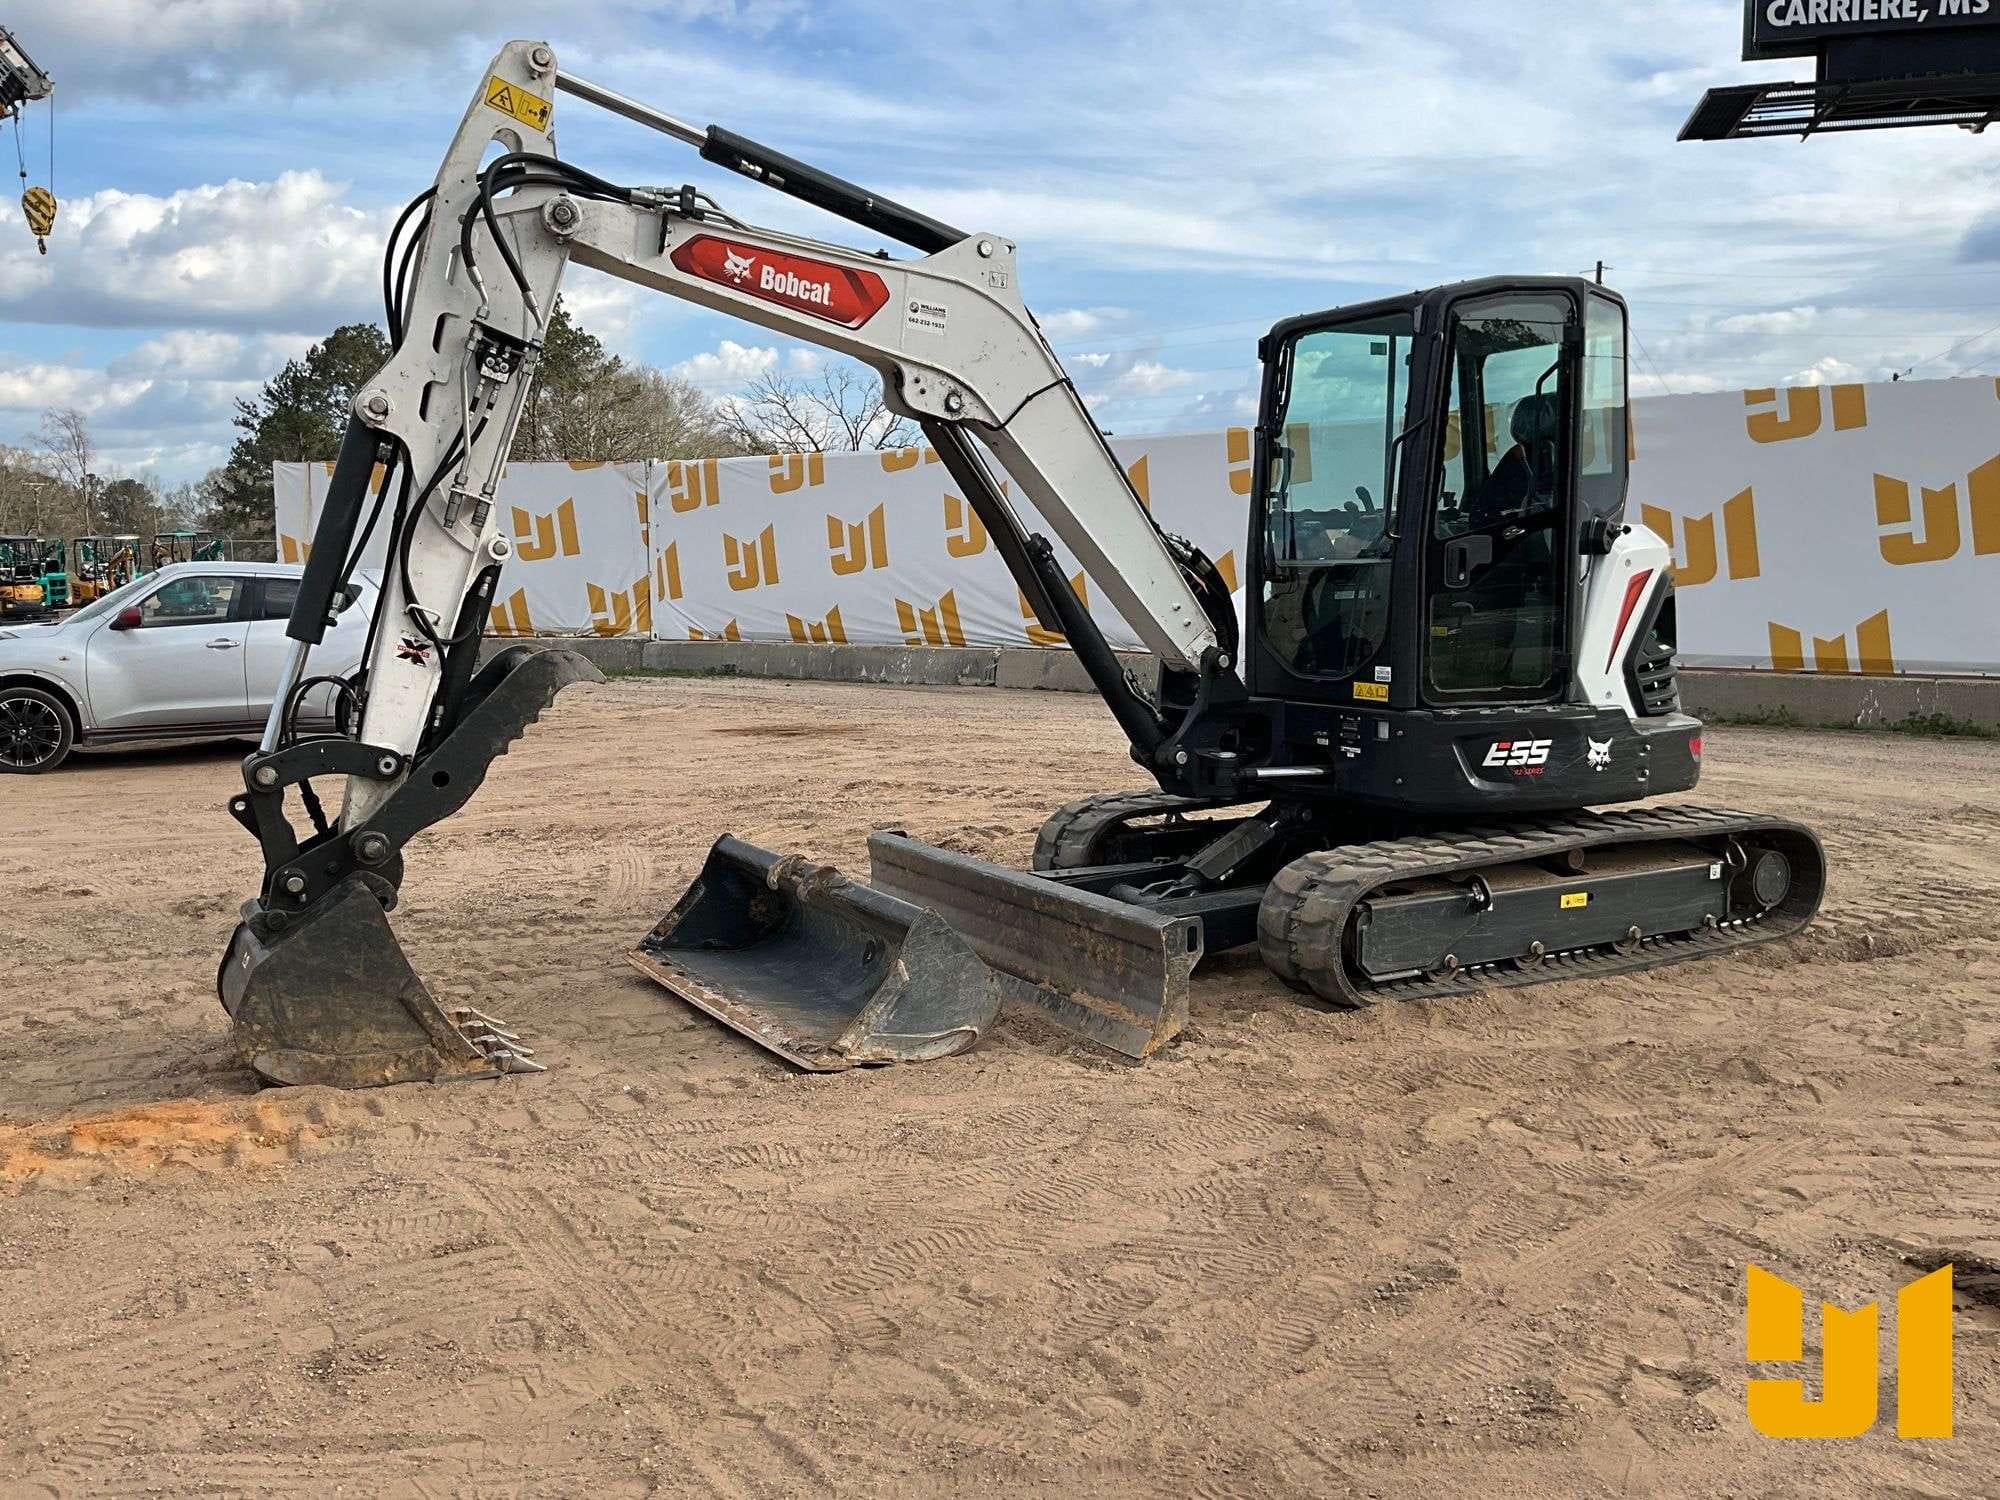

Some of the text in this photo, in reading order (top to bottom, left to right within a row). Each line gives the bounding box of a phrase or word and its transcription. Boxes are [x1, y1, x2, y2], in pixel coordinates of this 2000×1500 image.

[1766, 0, 1928, 27] CARRIERE,
[760, 265, 832, 306] Bobcat
[1482, 740, 1553, 767] E55
